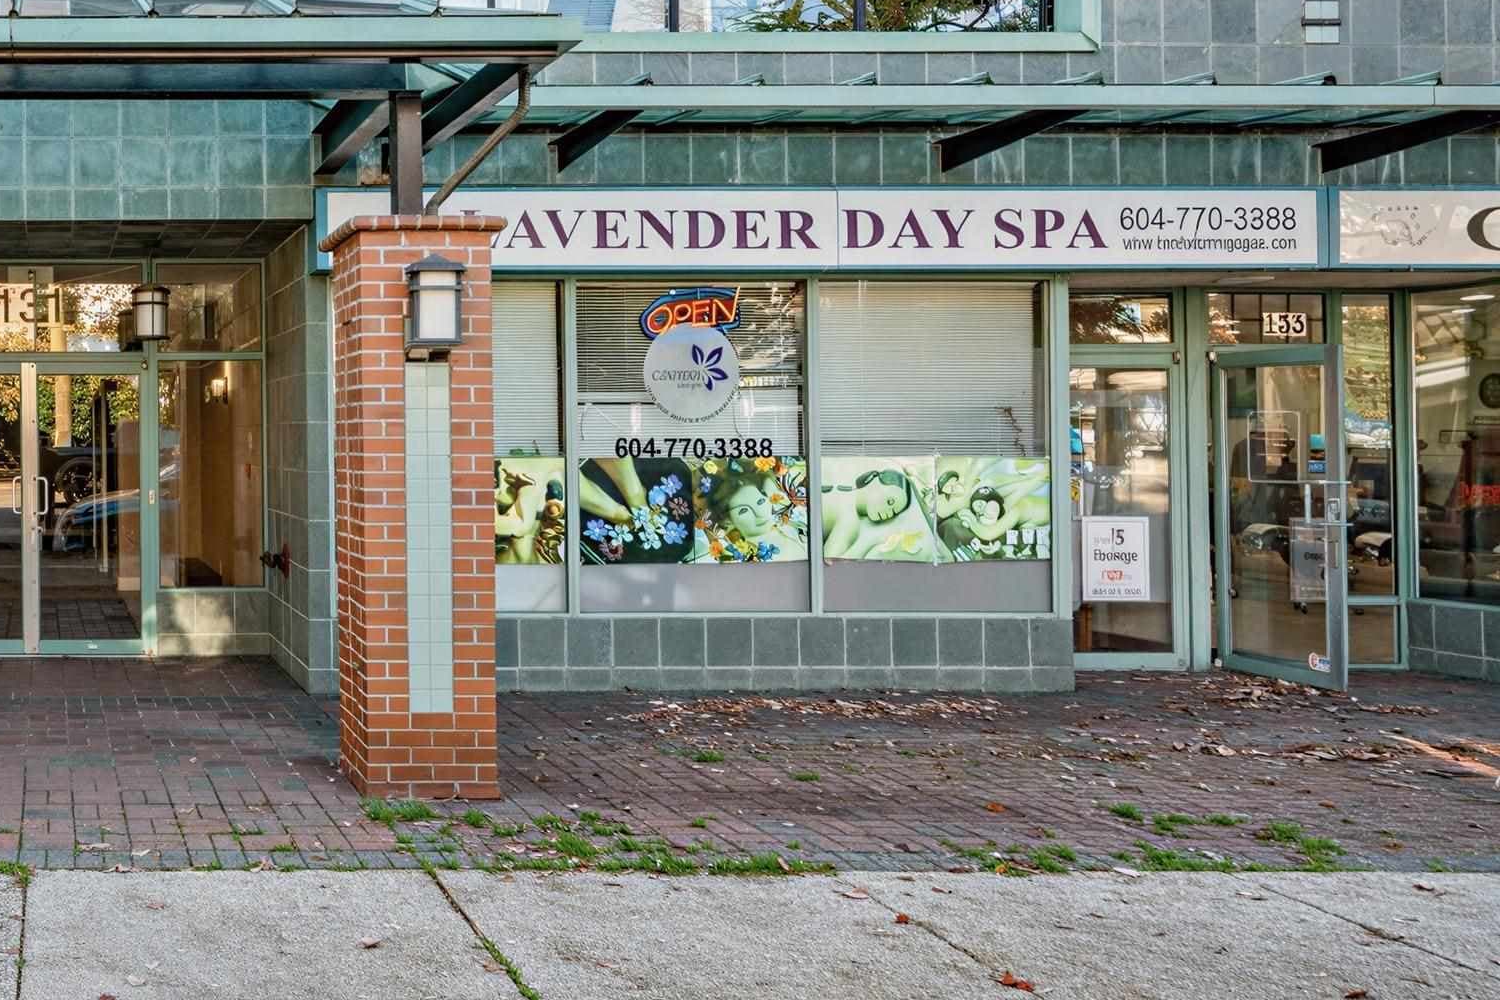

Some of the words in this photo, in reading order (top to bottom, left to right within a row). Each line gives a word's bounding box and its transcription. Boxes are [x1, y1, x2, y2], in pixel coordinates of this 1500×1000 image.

[460, 209, 821, 250] AVENDER
[841, 208, 975, 249] DAY
[993, 207, 1109, 250] SPA
[1119, 206, 1297, 231] 604-770-3388
[646, 285, 741, 336] OPEN
